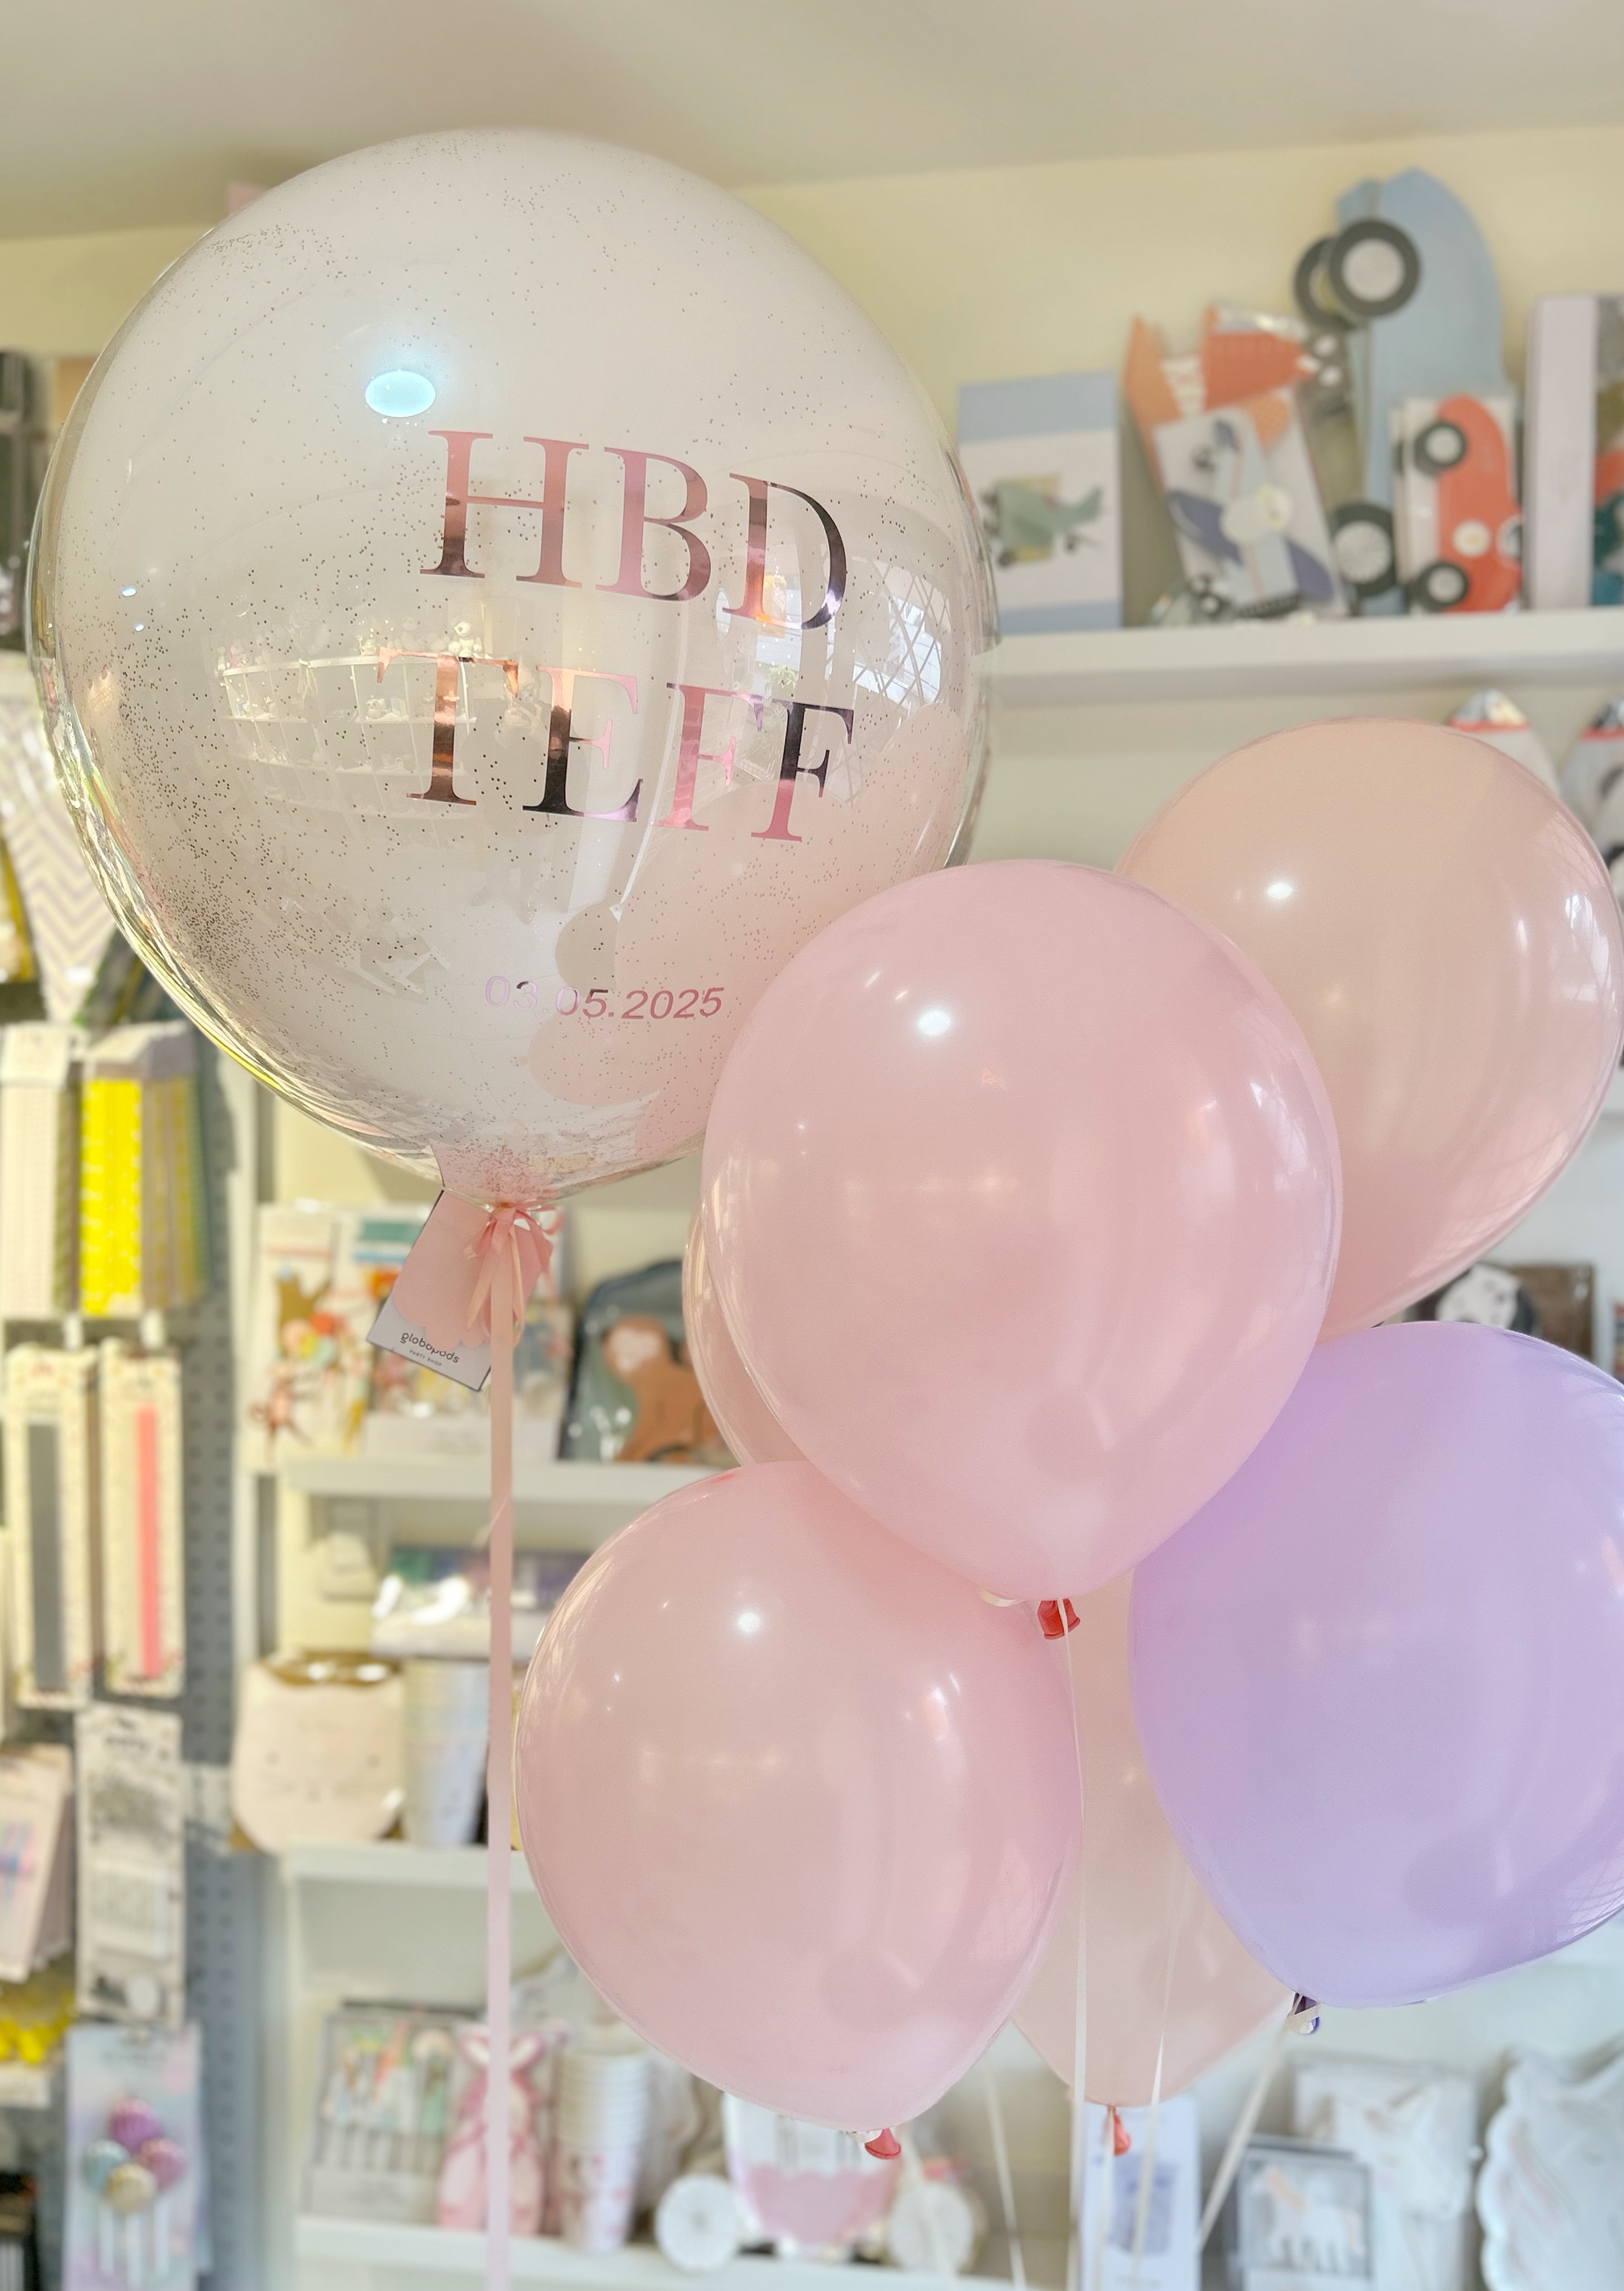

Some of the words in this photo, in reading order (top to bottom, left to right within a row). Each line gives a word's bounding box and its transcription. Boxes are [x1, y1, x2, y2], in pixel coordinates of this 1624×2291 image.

[420, 430, 848, 631] HBD
[376, 646, 855, 842] TEFF
[485, 975, 725, 1020] 03.05.2025
[400, 1332, 460, 1364] globopods
[409, 1349, 426, 1359] PARTY
[426, 1357, 443, 1366] SHOP
